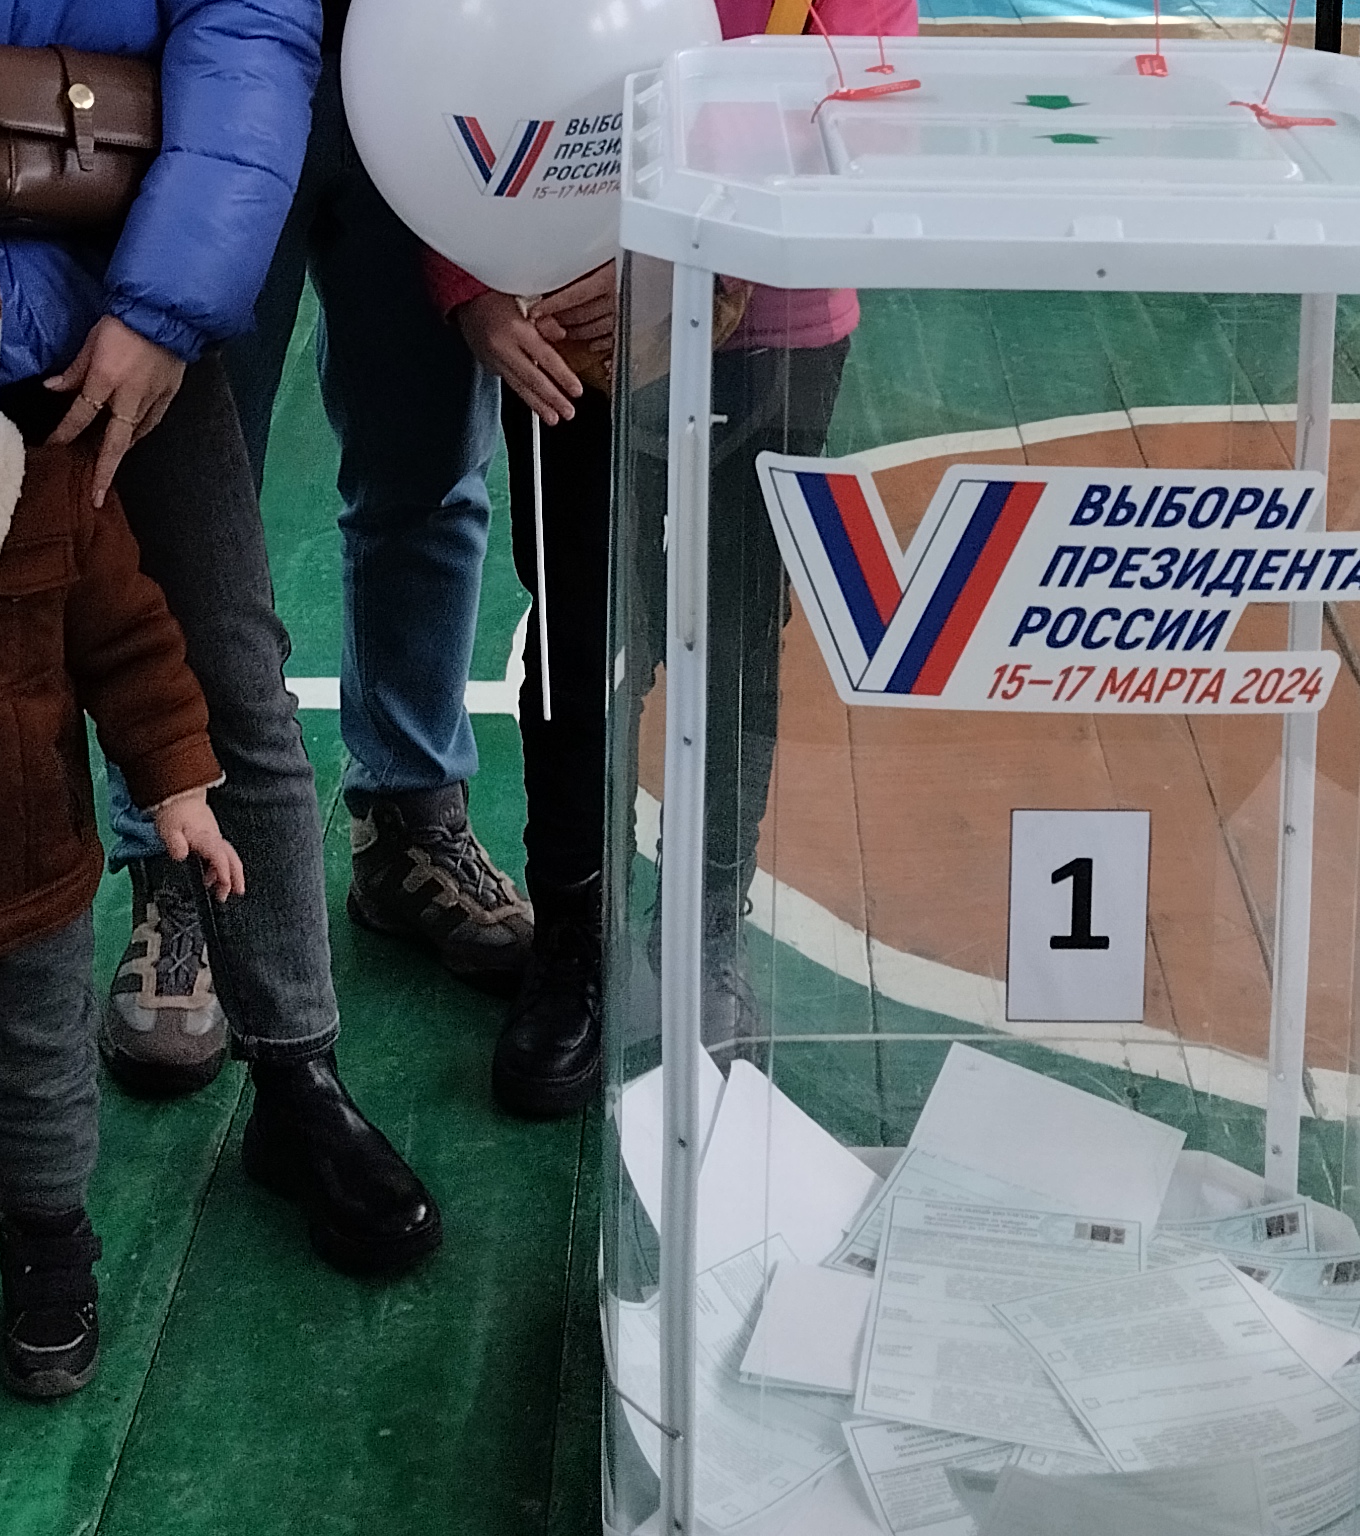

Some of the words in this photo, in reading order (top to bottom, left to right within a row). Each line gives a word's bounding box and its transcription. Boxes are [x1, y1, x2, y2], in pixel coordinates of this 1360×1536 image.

[565, 112, 623, 136] ВЫБО
[554, 137, 621, 160] ПРЕЗИ
[1069, 484, 1316, 531] ВЫБОРЫ
[1009, 606, 1232, 652] РОССИИ
[1096, 665, 1227, 704] МАРТА
[1230, 667, 1323, 705] 2024
[1050, 858, 1110, 950] 1
